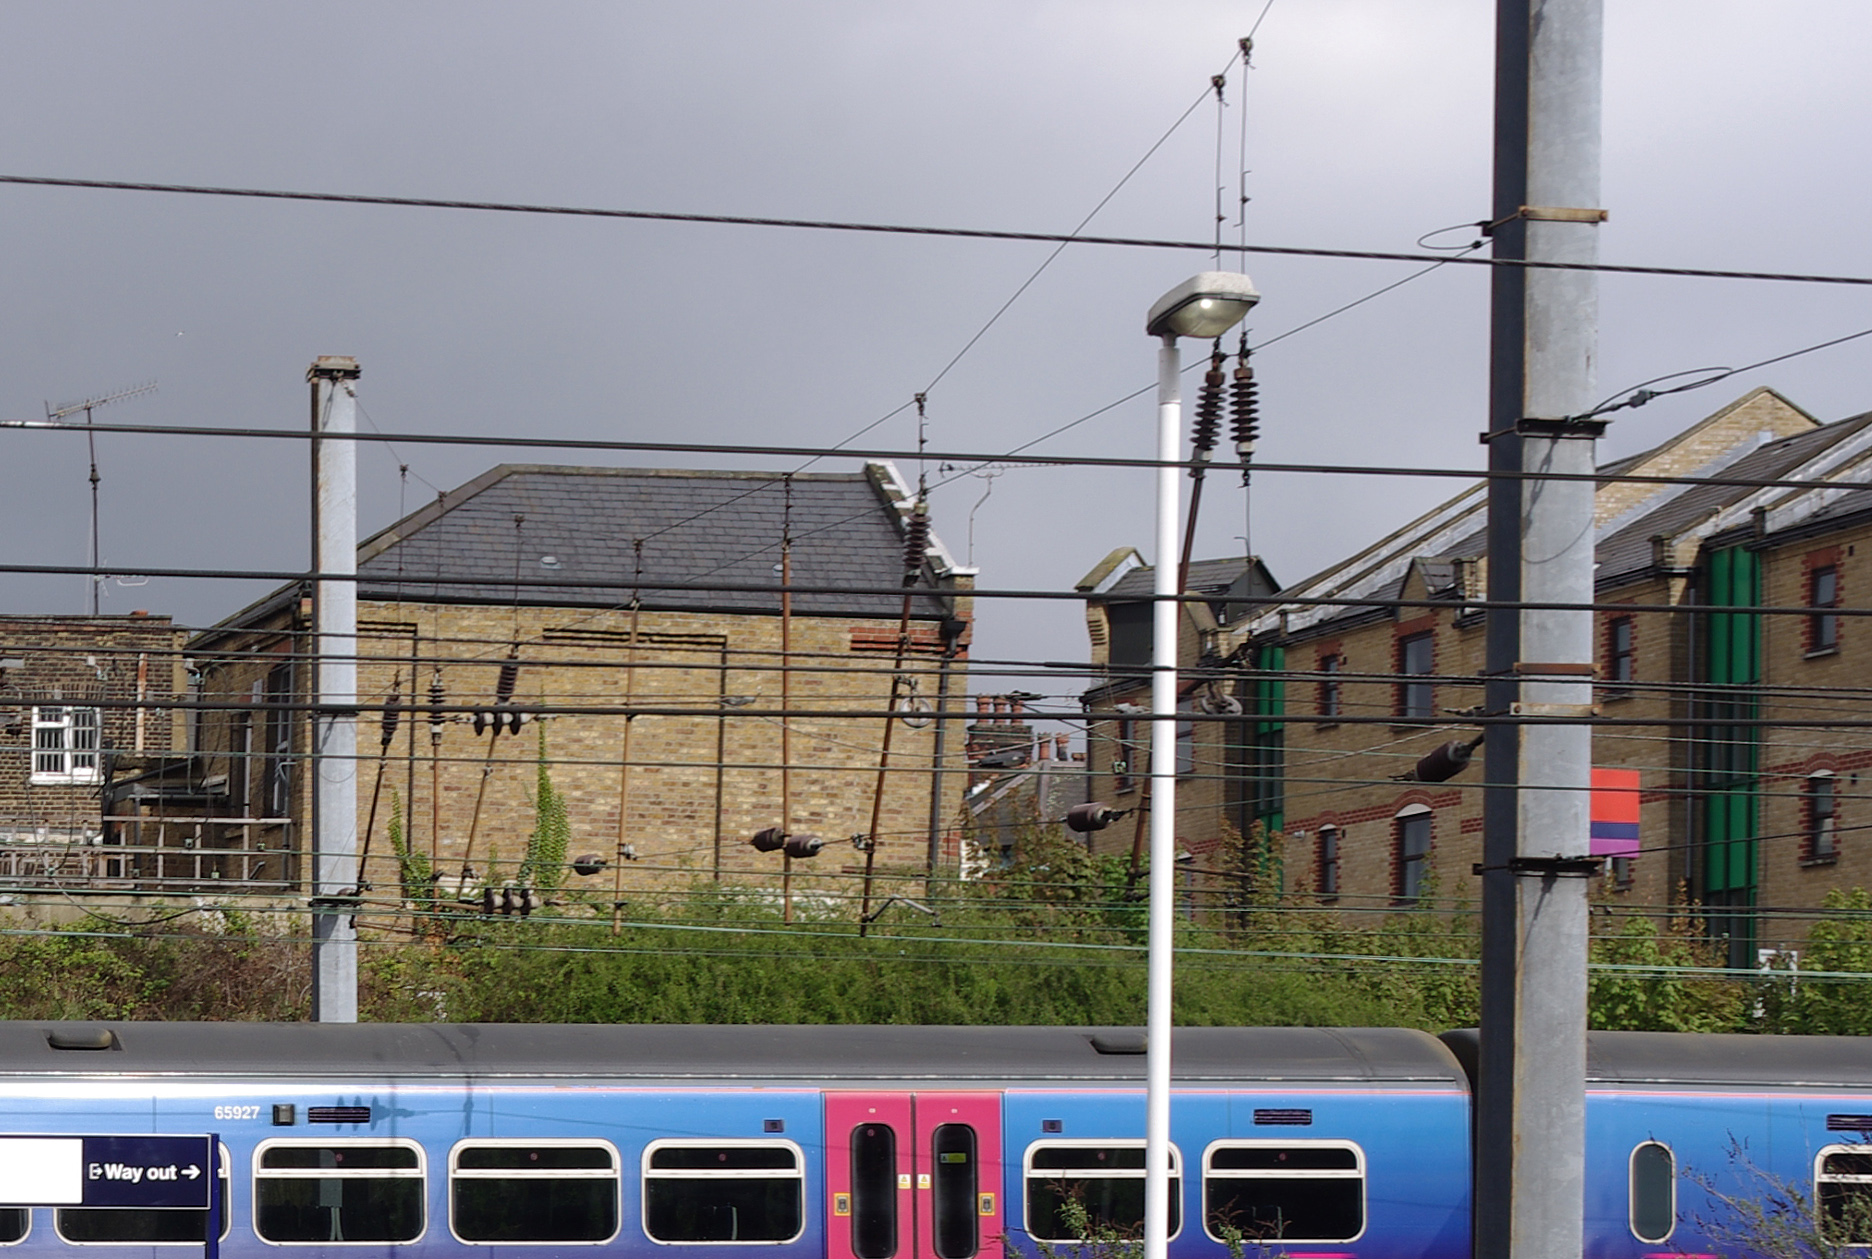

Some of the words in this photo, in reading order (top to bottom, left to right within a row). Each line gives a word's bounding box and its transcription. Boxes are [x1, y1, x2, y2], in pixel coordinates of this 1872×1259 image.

[214, 1105, 260, 1120] 65927
[103, 1163, 143, 1184] Way
[146, 1164, 178, 1180] out
